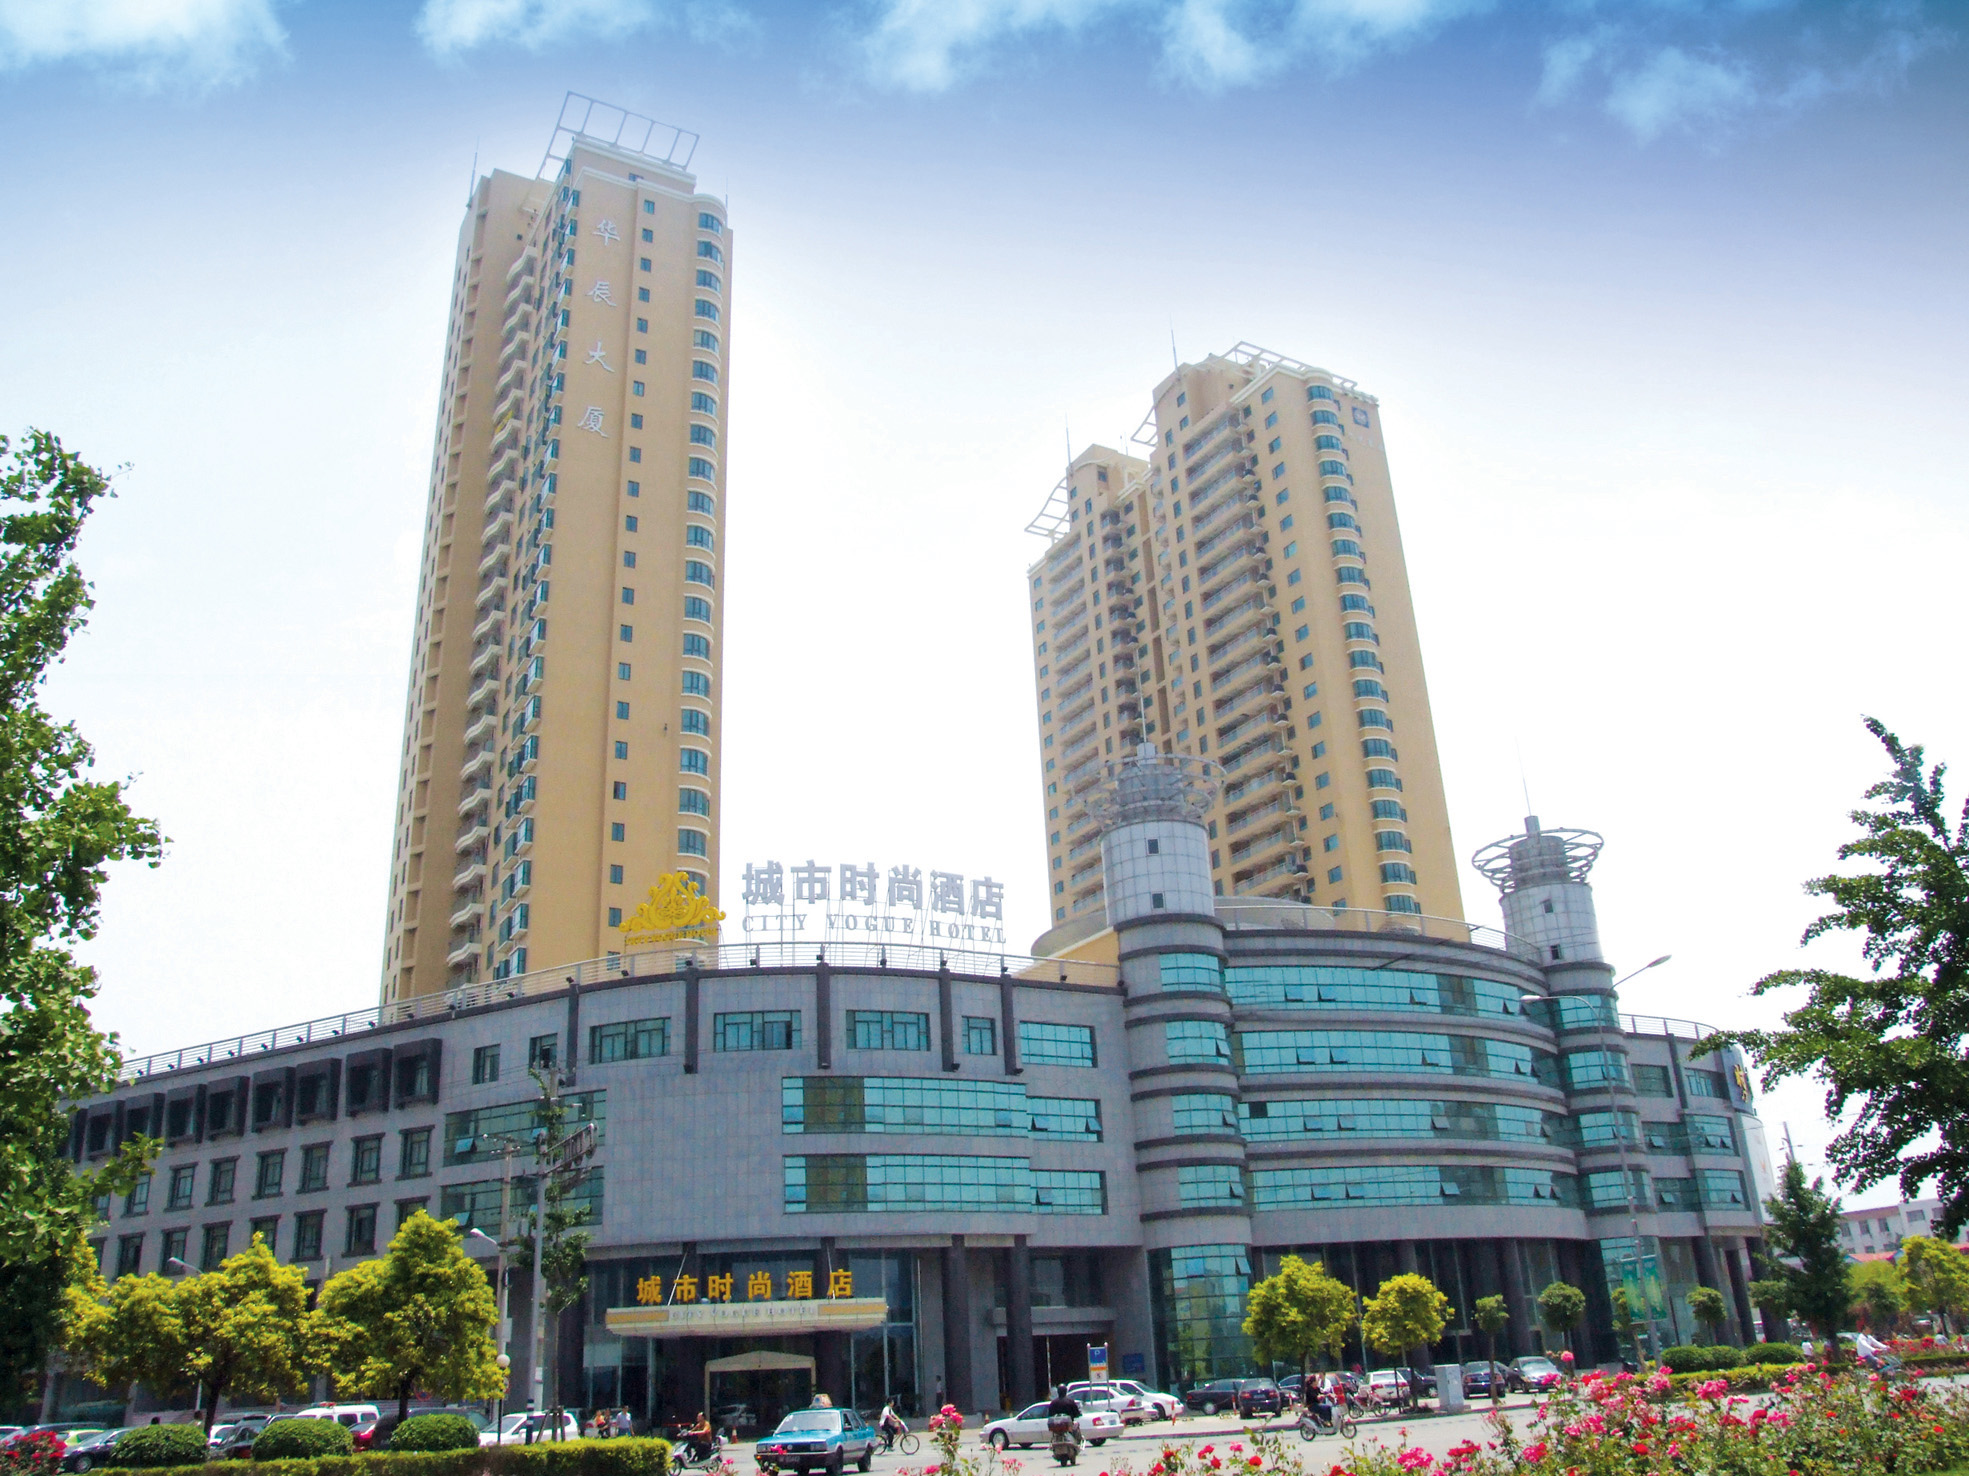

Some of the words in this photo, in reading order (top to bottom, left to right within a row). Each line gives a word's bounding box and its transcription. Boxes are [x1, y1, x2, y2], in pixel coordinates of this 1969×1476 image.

[577, 219, 621, 438] 华辰大厦
[742, 859, 1004, 921] 城市时尚酒店
[742, 914, 807, 932] CITY
[826, 914, 914, 934] VOGUE
[929, 920, 1006, 943] HOTEL
[636, 1269, 854, 1304] 城市时尚酒店
